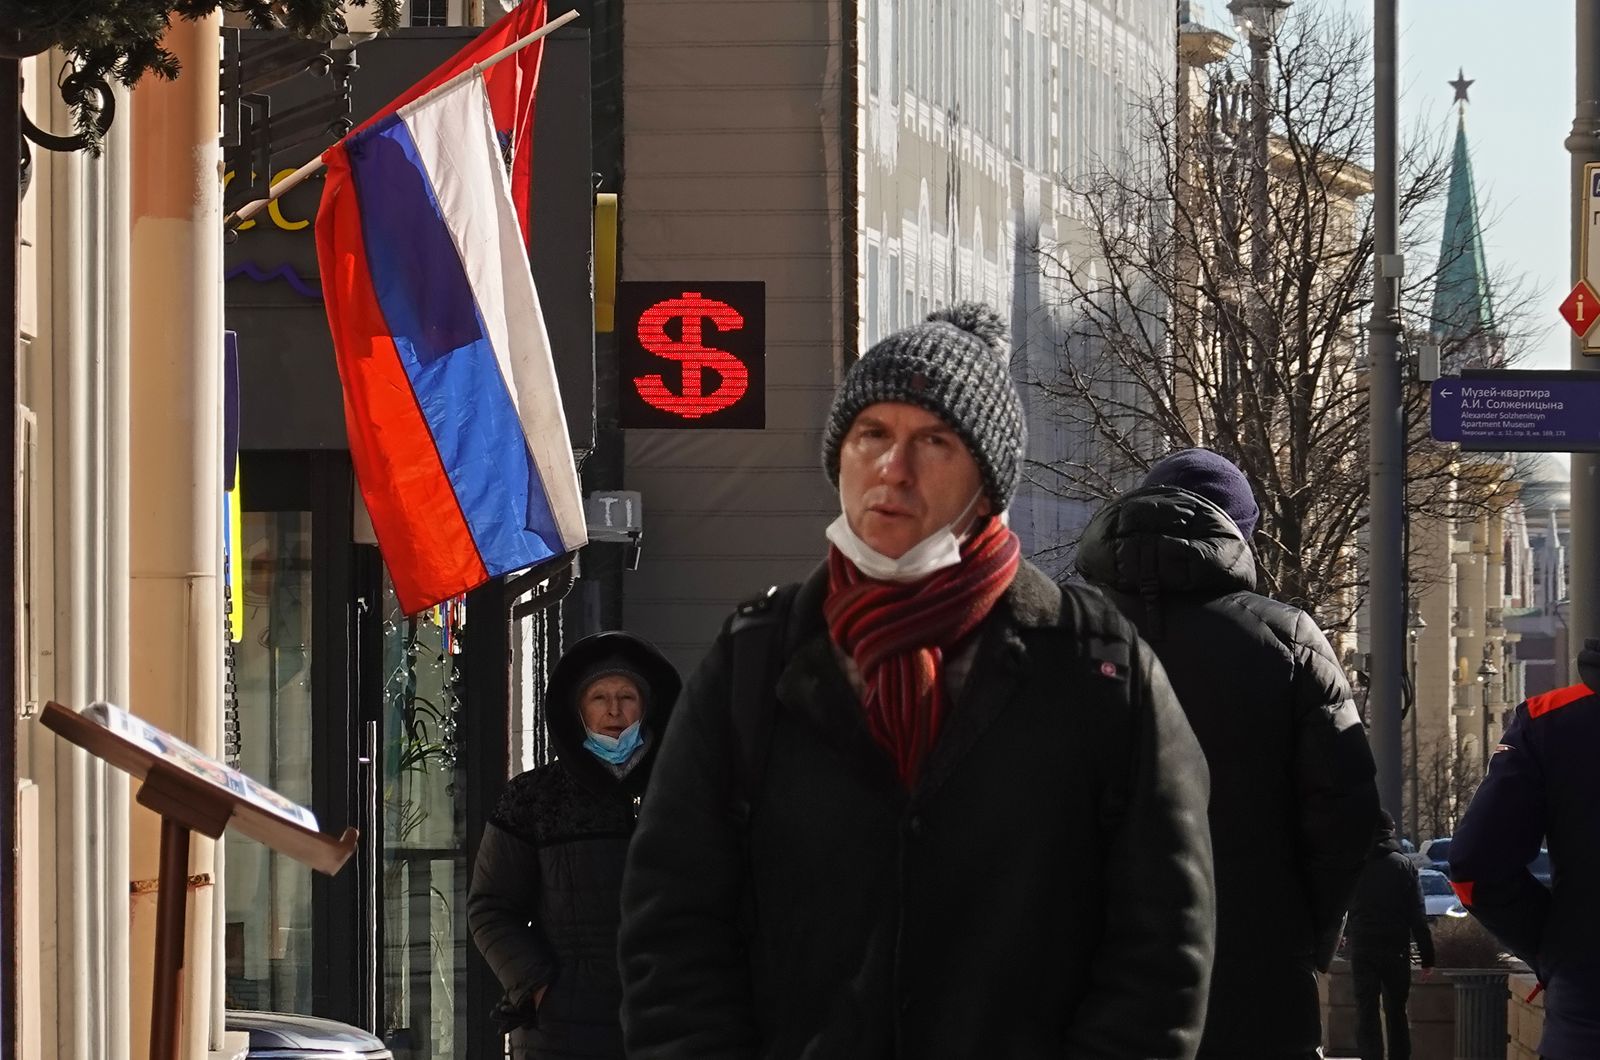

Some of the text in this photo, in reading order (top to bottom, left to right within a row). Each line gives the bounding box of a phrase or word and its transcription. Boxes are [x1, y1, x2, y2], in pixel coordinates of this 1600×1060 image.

[633, 292, 748, 418] $
[1461, 387, 1551, 400] Музей-квартира
[1460, 399, 1564, 411] А.И. Солженицына
[1461, 411, 1546, 421] Alexander Solzhenitsyn
[1461, 420, 1536, 429] Apartment Museum
